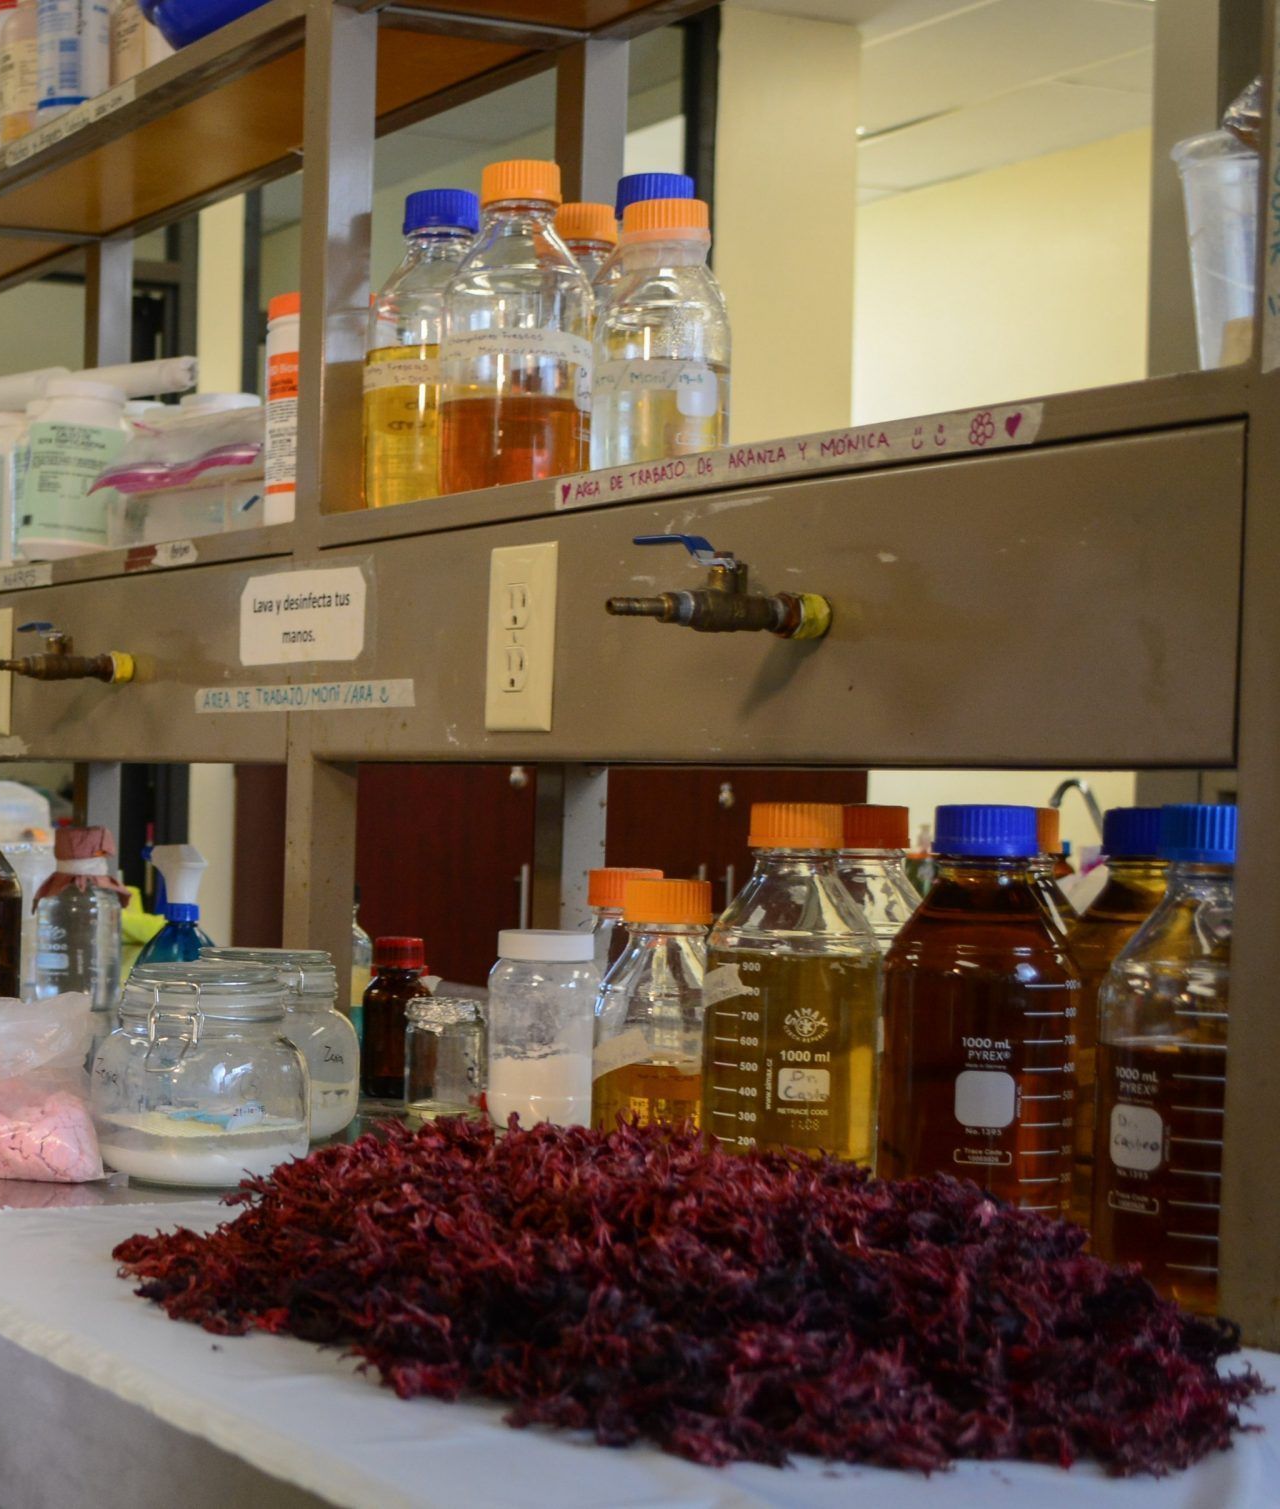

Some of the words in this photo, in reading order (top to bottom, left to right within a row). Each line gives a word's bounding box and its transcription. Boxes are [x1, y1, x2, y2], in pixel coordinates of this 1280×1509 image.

[610, 475, 623, 491] DE
[630, 461, 686, 486] TRABAJO
[697, 457, 713, 475] DE
[728, 447, 787, 469] ARANZA
[798, 442, 807, 460] Y
[820, 432, 890, 457] MÓNICA
[253, 598, 273, 614] Lava
[275, 601, 281, 615] y
[283, 592, 332, 612] desinfecta
[334, 592, 350, 607] tus
[281, 630, 316, 644] manos.
[237, 690, 250, 708] DE
[742, 962, 761, 971] 900
[741, 1011, 759, 1021] 700
[784, 1007, 829, 1027] SIMAX
[740, 1036, 759, 1046] 600
[961, 1037, 992, 1048] 1000
[994, 1039, 1011, 1049] mL
[780, 1050, 811, 1062] 1000
[814, 1051, 830, 1062] ml
[740, 1062, 758, 1072] 500
[1115, 1067, 1139, 1080] 1000
[1142, 1072, 1158, 1083] mL
[738, 1087, 757, 1097] 400
[738, 1112, 756, 1121] 300
